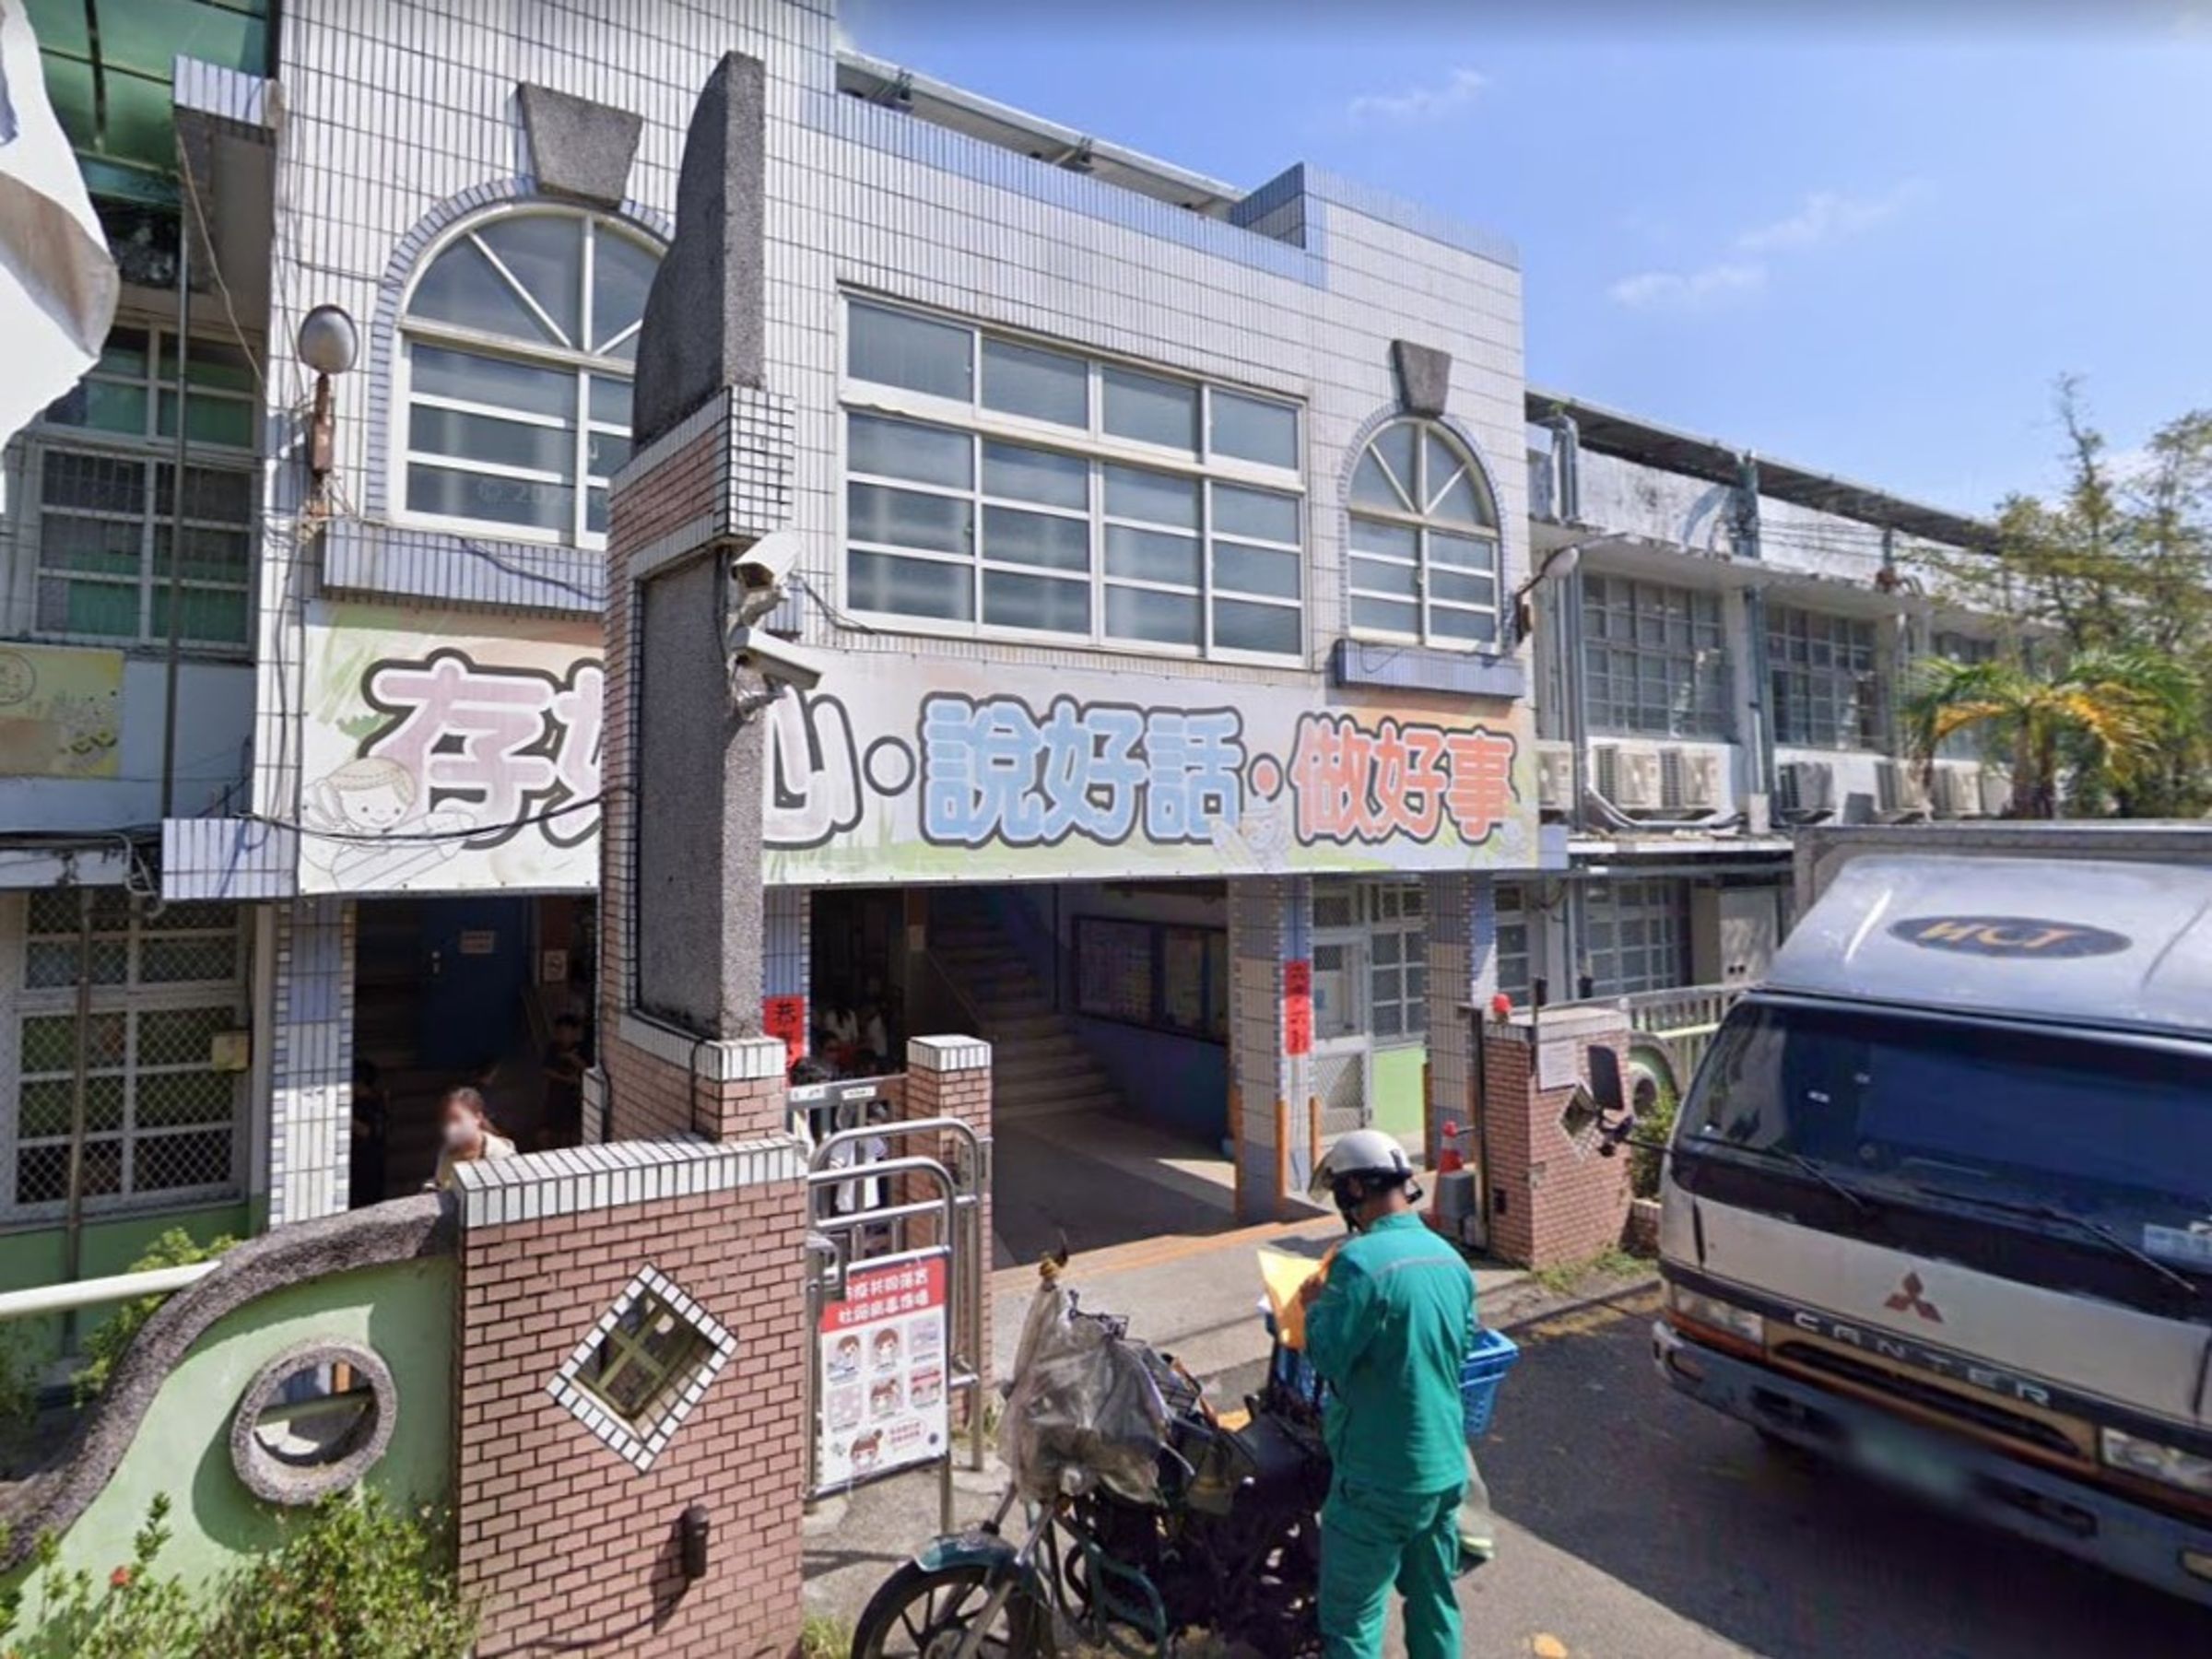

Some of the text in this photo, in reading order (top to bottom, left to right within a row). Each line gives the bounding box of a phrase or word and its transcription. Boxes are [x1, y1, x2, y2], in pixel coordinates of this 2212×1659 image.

[920, 693, 1244, 848] 說好話
[1290, 712, 1519, 846] 做好事
[1794, 1312, 2050, 1407] CANTER
